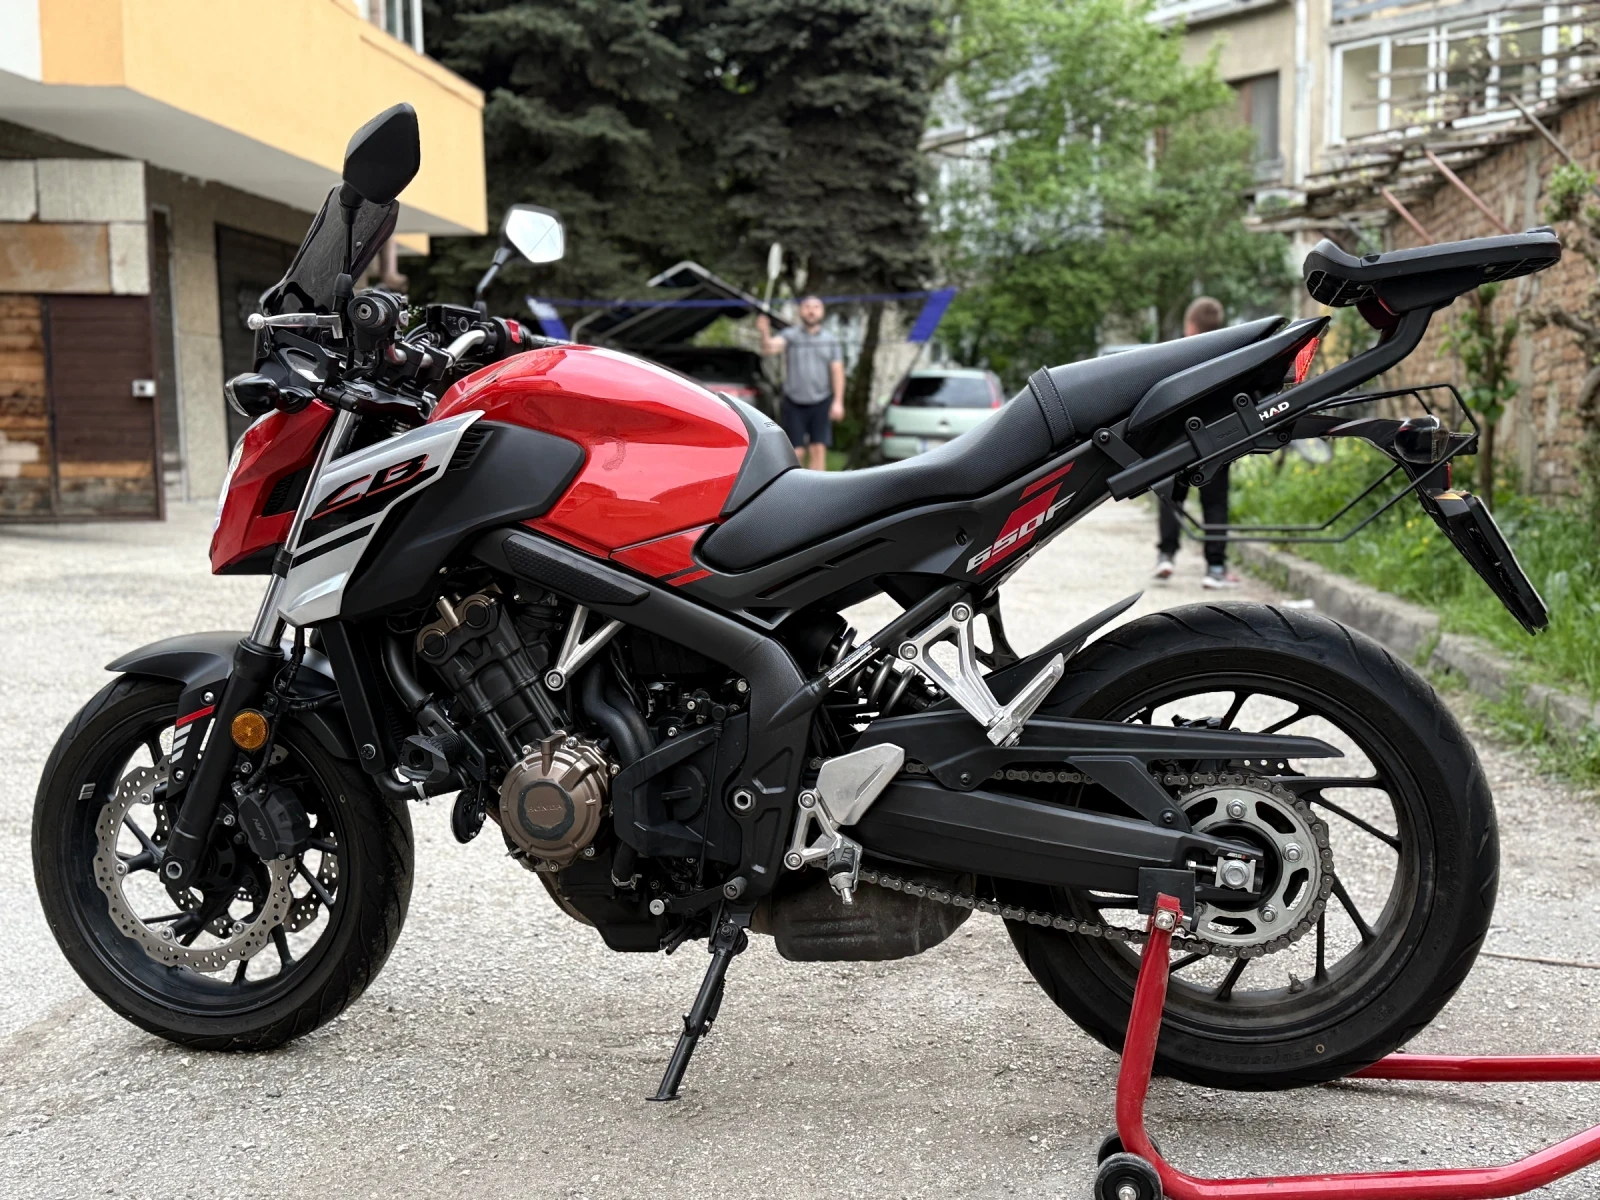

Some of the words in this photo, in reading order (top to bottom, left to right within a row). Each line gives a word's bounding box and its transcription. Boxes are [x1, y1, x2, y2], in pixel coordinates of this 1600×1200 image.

[1258, 401, 1290, 421] HAD
[311, 453, 430, 520] CB
[966, 491, 1077, 573] 650F
